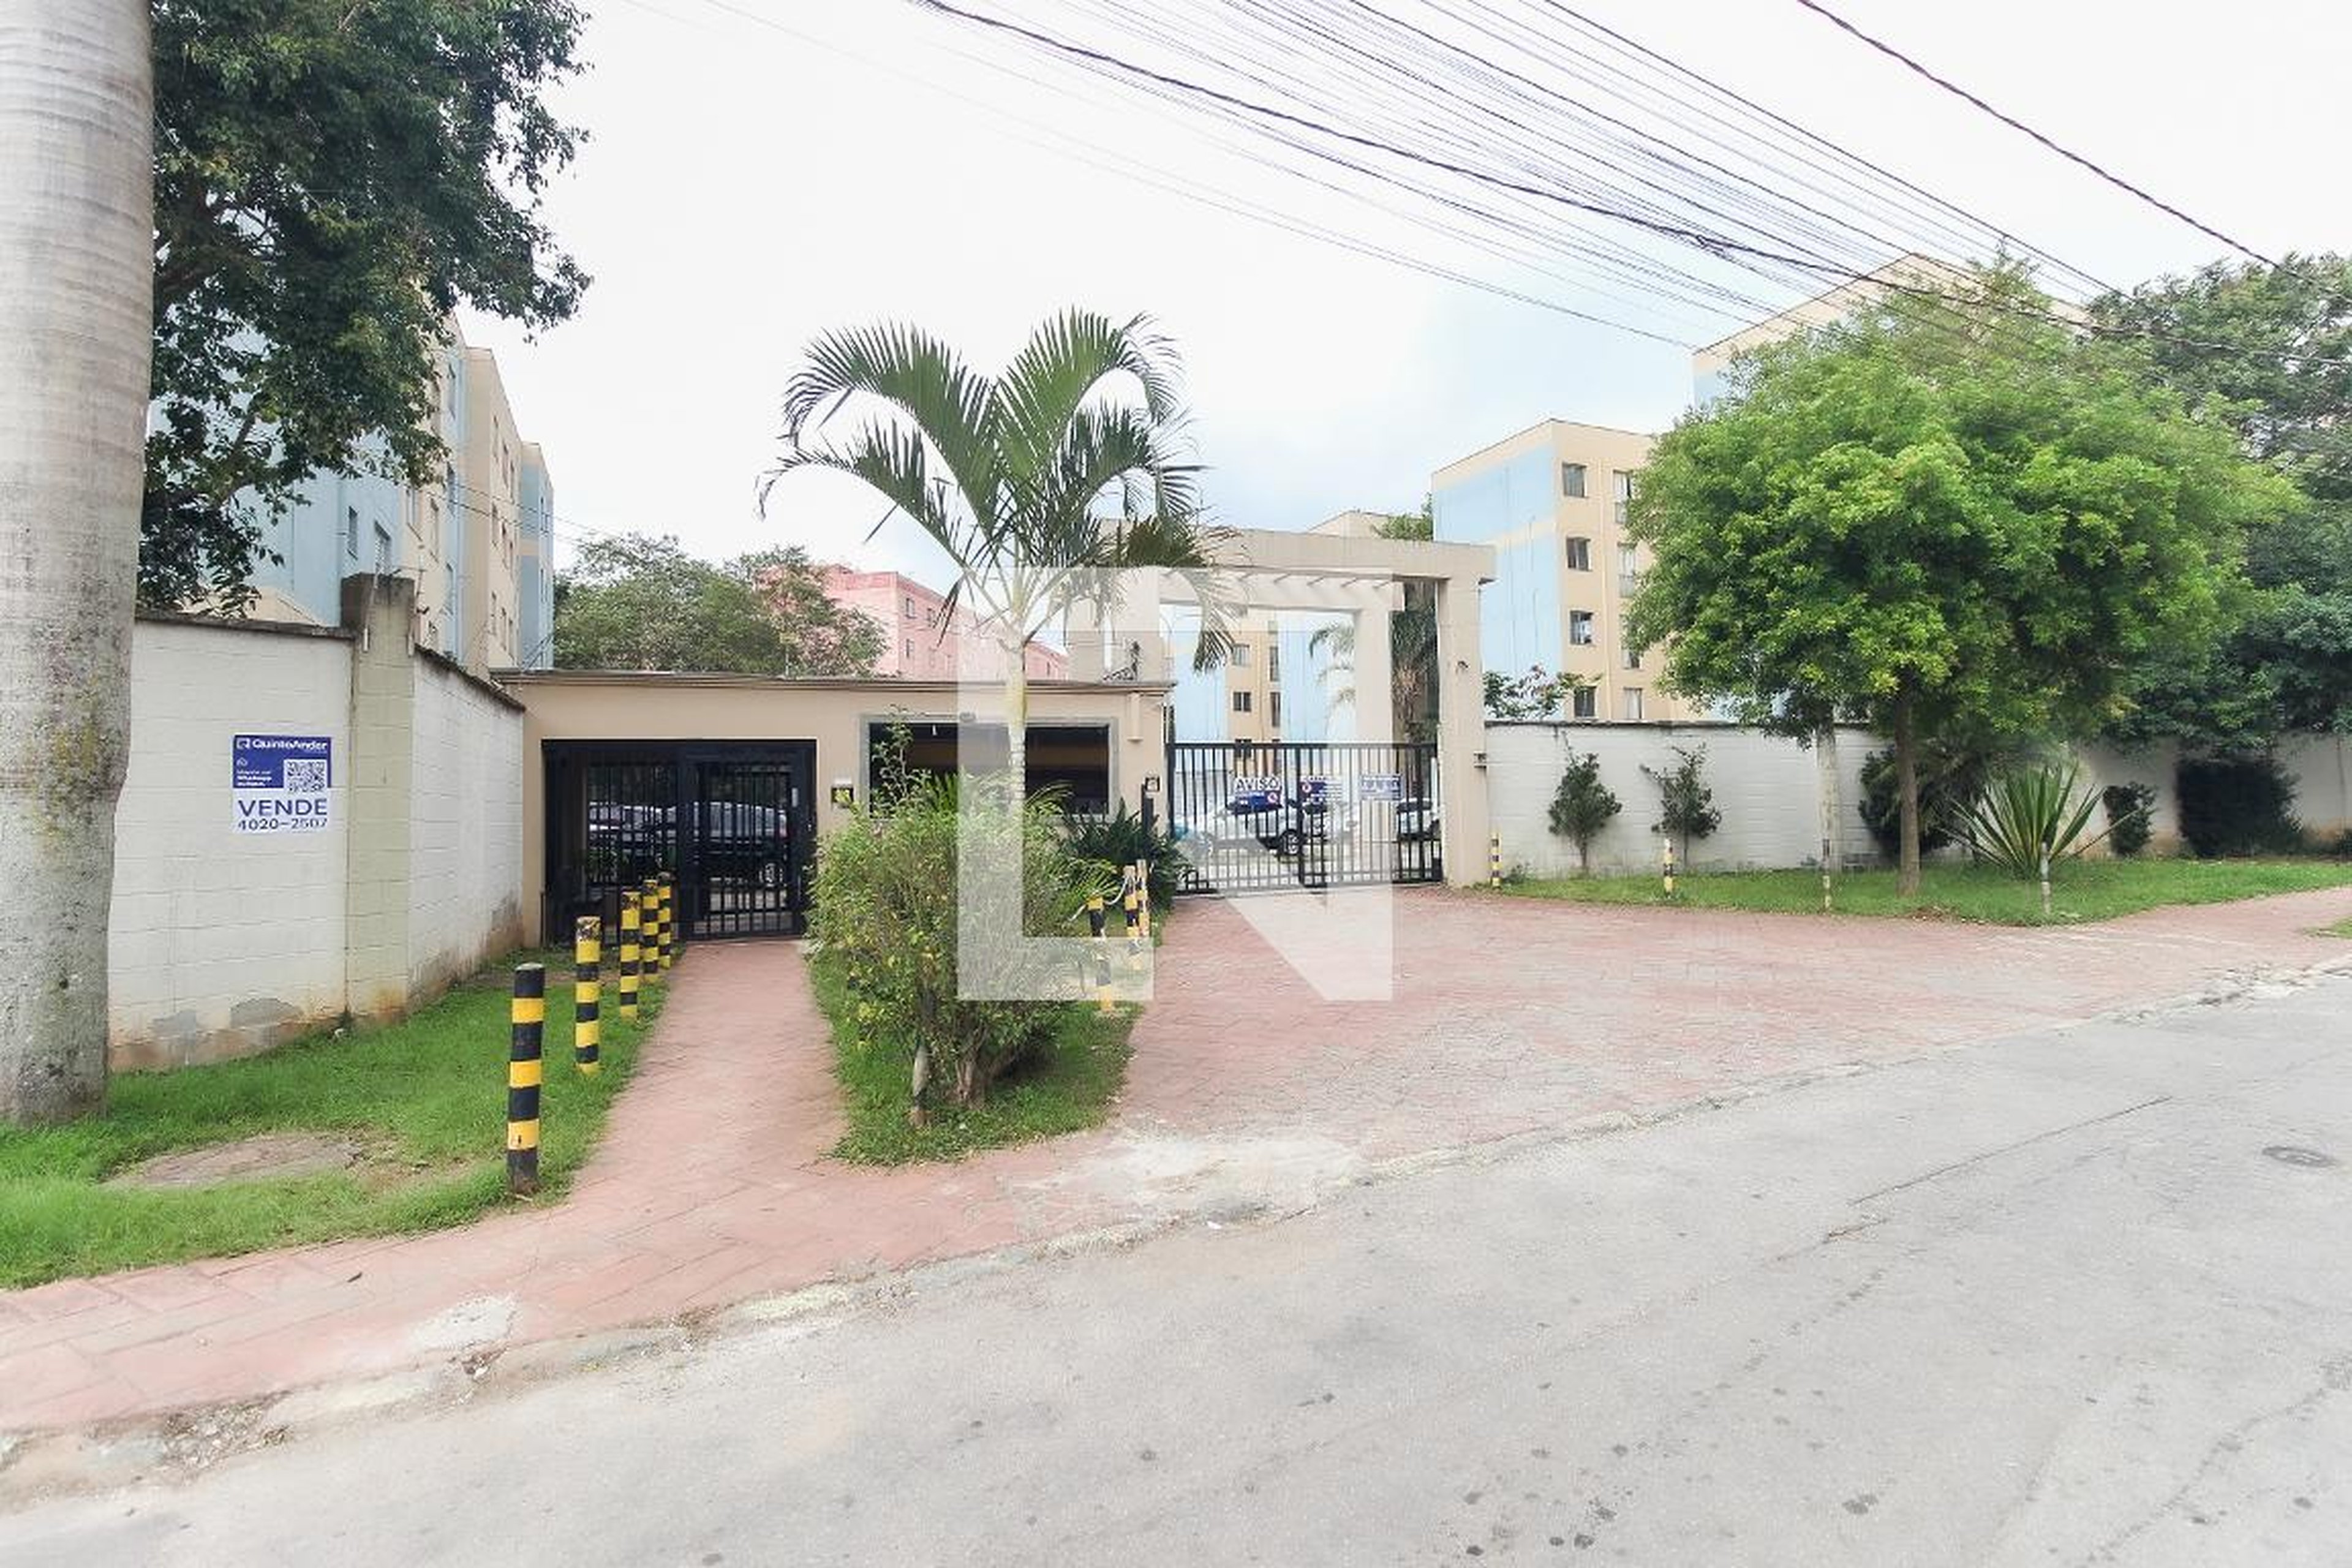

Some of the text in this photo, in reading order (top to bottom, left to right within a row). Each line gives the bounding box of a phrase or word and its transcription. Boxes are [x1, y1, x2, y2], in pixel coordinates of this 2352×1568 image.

[1237, 777, 1279, 791] AVISO
[238, 798, 328, 817] VENDE
[238, 818, 328, 831] 4020-2507
